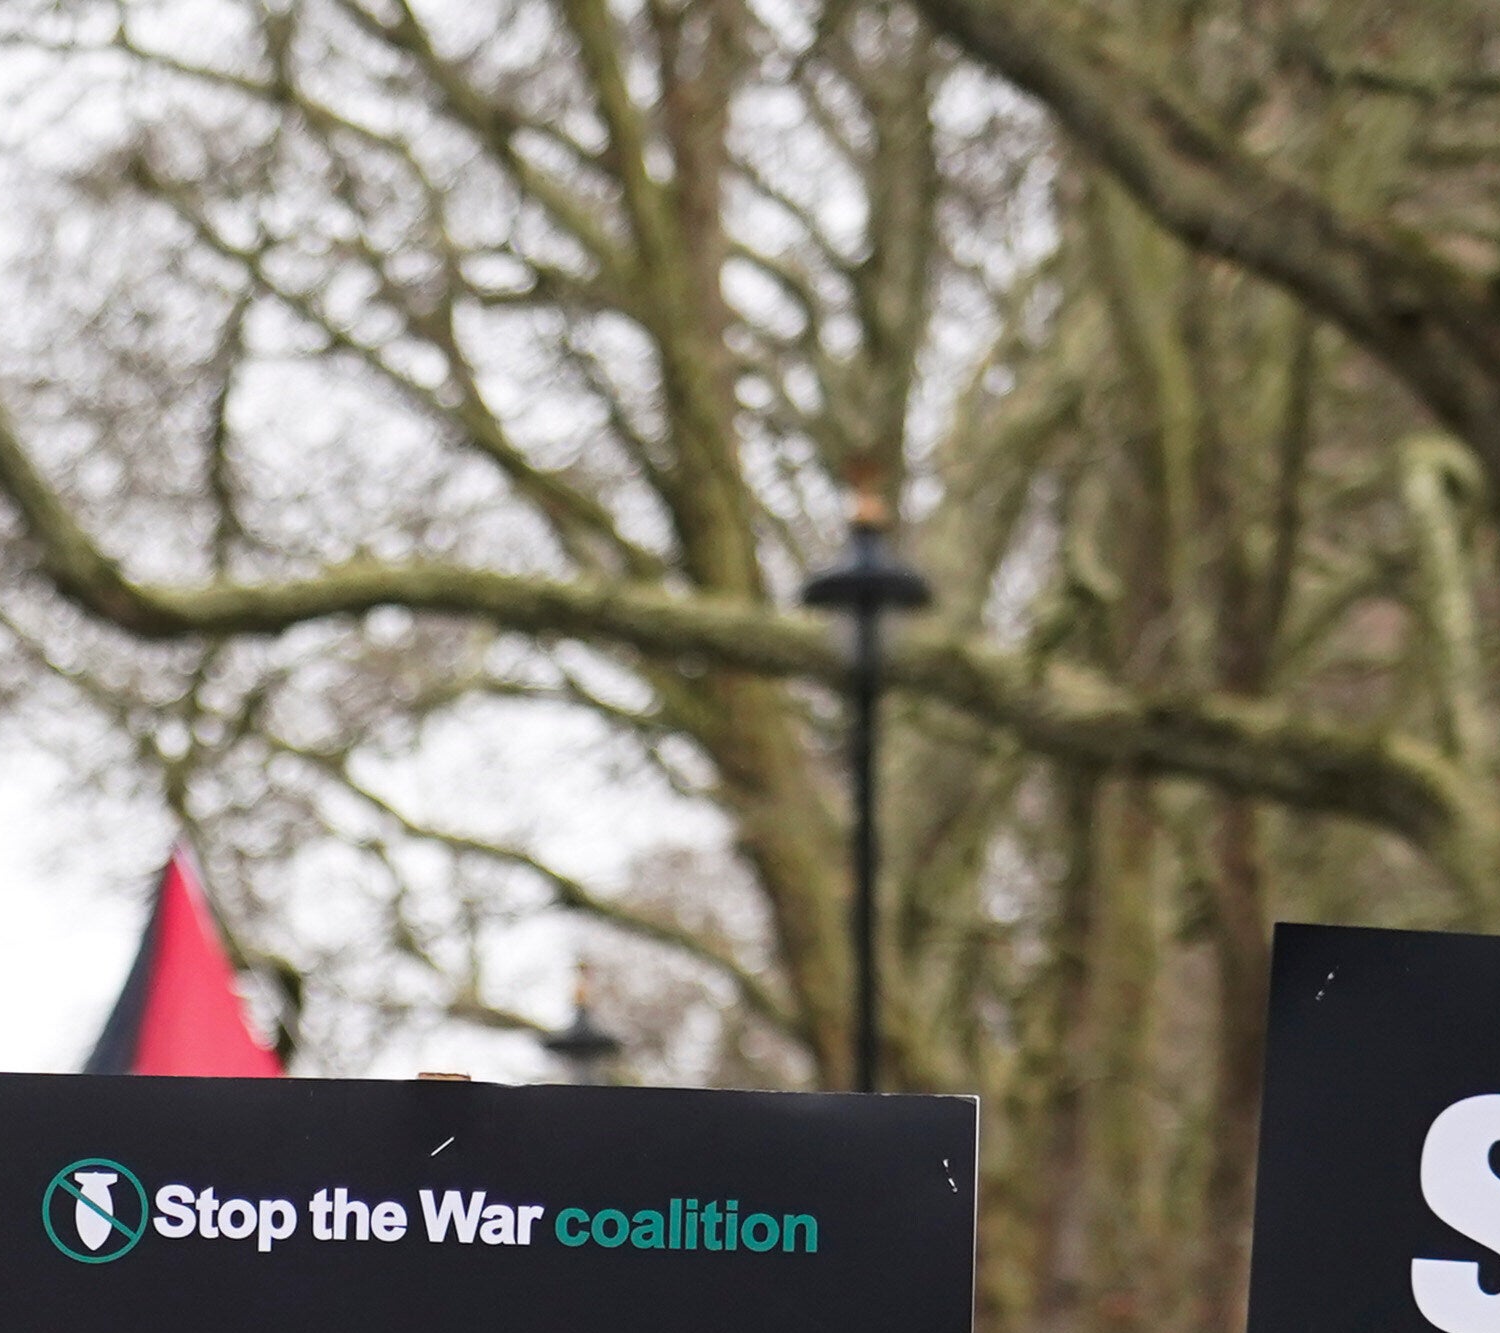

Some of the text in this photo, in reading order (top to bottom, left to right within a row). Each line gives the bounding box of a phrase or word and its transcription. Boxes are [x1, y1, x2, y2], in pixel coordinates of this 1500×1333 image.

[152, 1184, 819, 1253] Stop the War coalition
